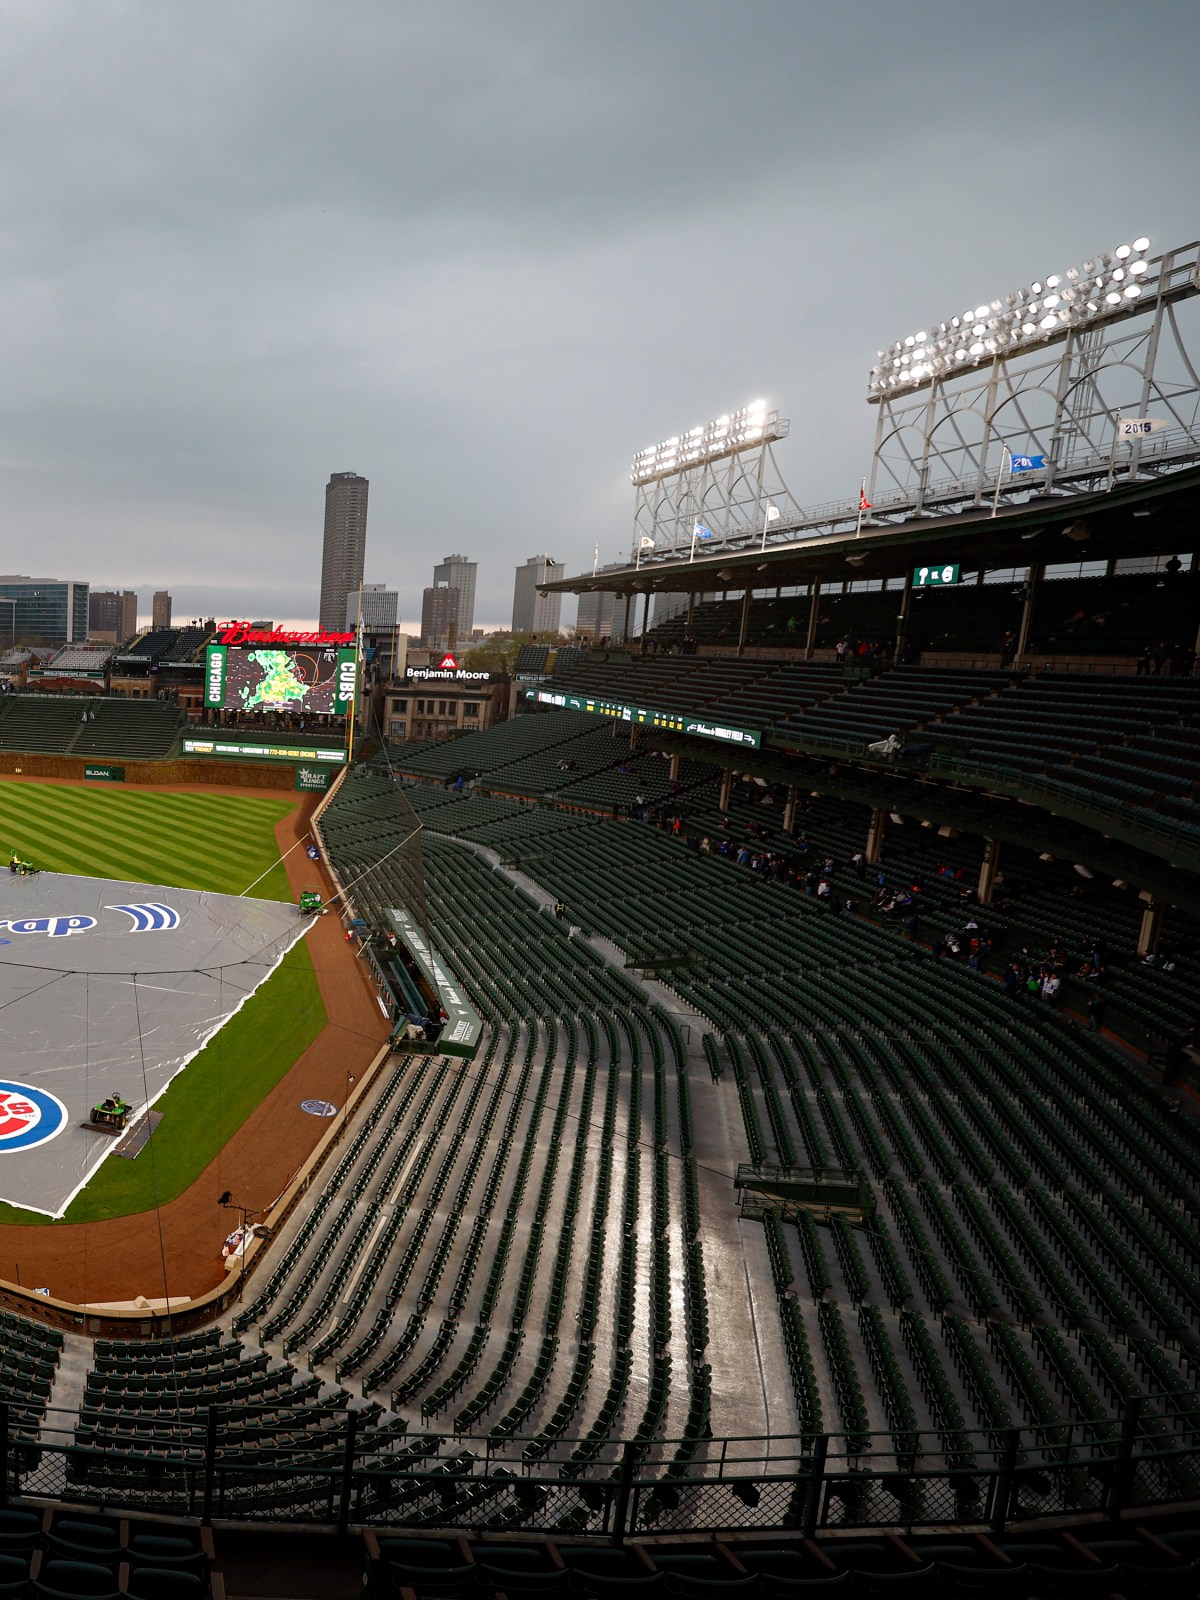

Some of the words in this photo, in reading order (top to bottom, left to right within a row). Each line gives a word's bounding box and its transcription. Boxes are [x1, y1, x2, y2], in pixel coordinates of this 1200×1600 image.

[1125, 423, 1151, 434] 2015
[217, 621, 355, 645] Budweiser
[209, 653, 223, 702] CHICAGO
[338, 661, 357, 701] CUBS
[406, 668, 453, 680] Benjamin
[456, 669, 490, 680] Moore
